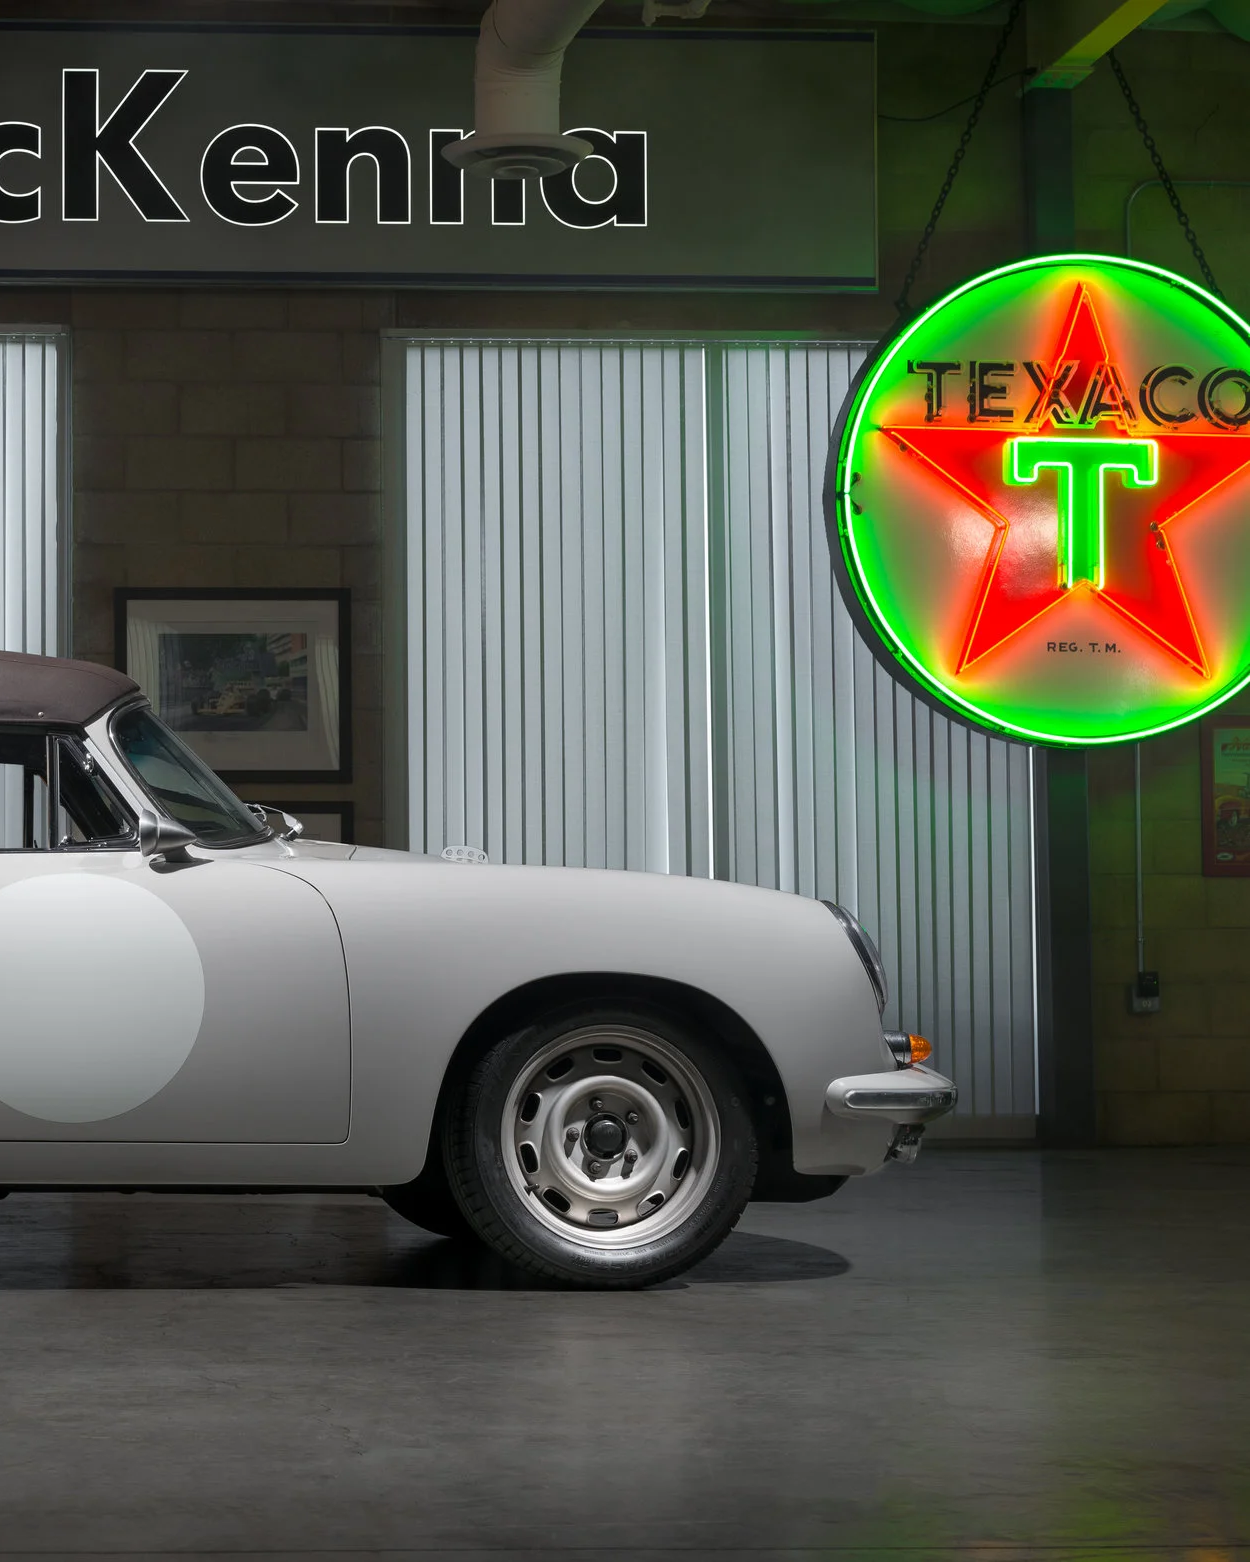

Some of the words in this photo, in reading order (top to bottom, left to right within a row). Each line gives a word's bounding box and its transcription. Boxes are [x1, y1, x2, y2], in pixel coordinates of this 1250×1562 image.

[907, 359, 1250, 431] TEXACO
[1002, 435, 1159, 590] T
[1046, 641, 1083, 653] REG.
